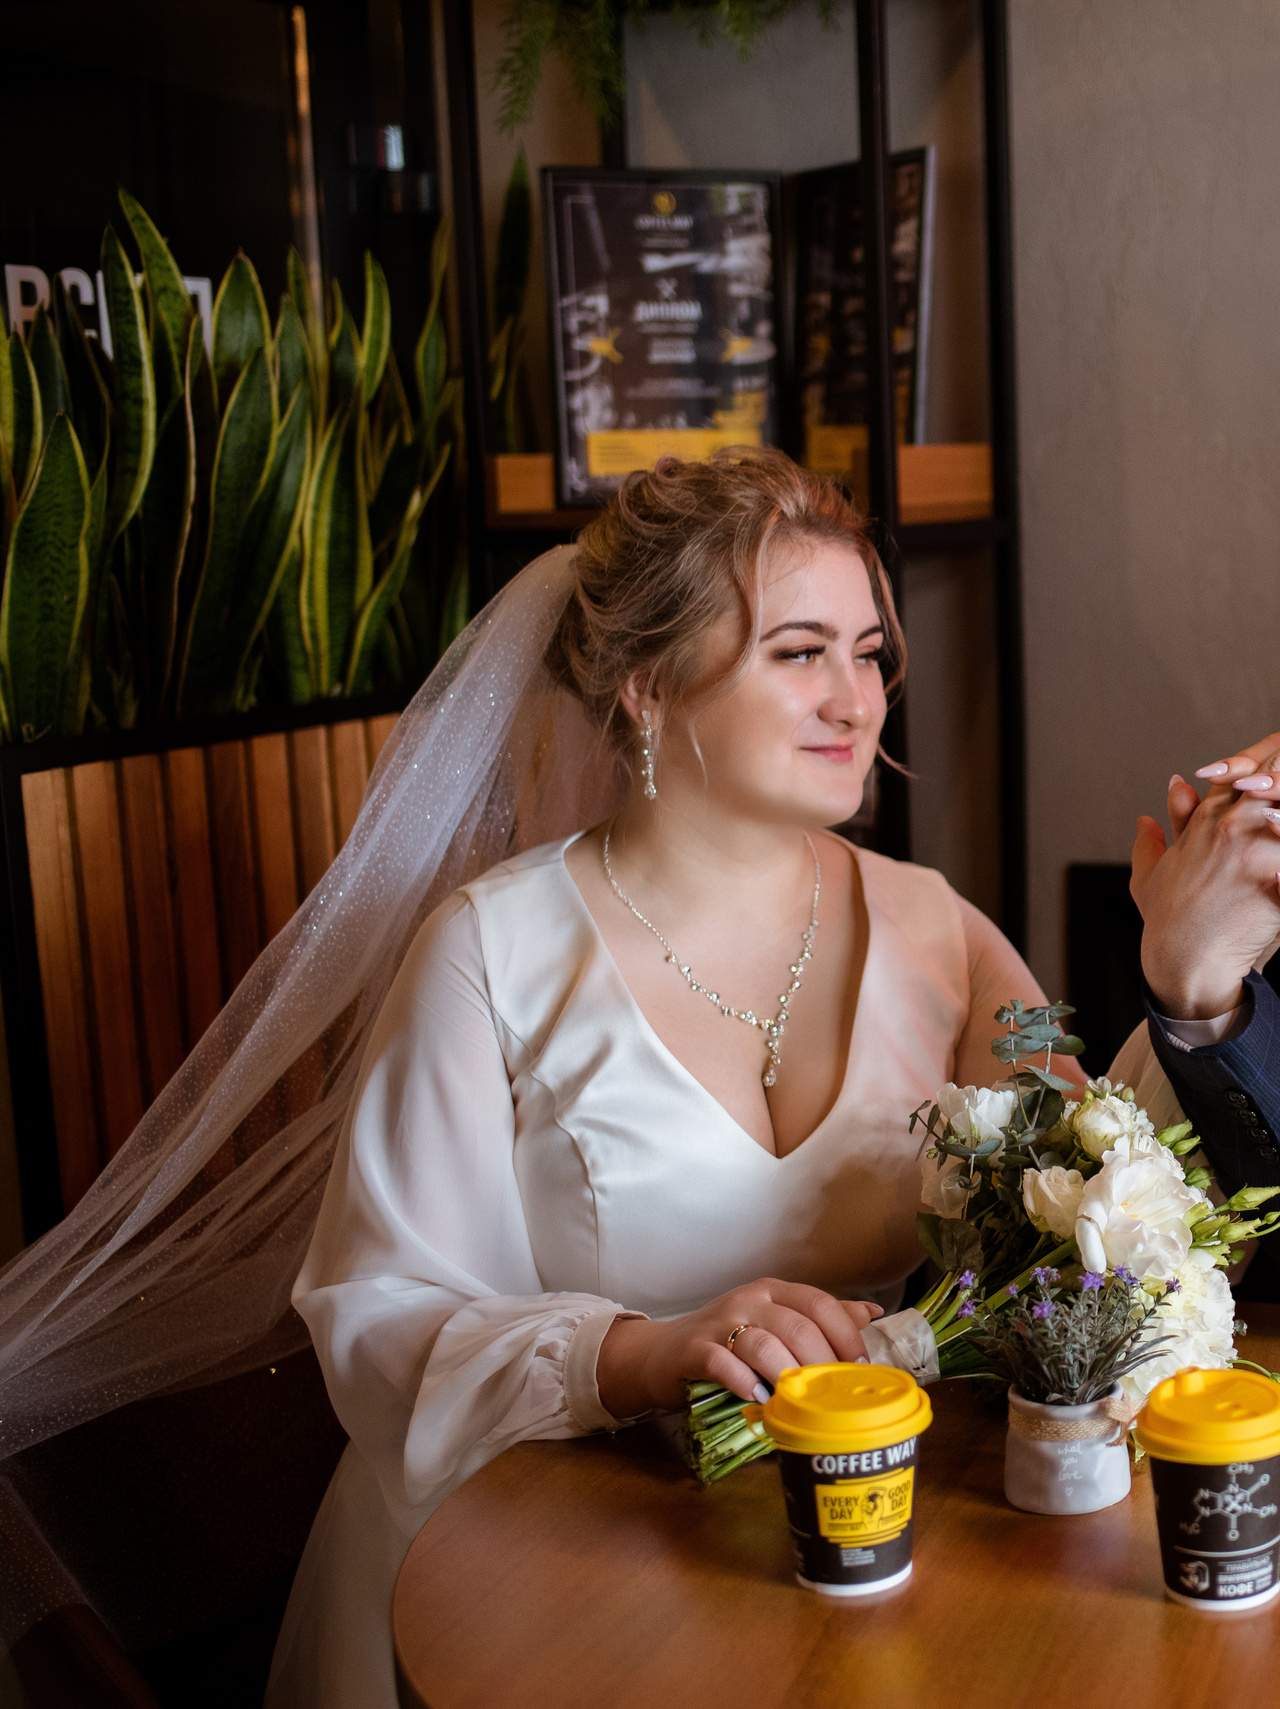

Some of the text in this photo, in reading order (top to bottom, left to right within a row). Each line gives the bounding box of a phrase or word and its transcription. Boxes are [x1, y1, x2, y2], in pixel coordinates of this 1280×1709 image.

[812, 1436, 917, 1474] COFFEE WAY
[1057, 1442, 1083, 1455] what
[1061, 1457, 1078, 1471] you
[1057, 1470, 1083, 1482] love
[888, 1480, 911, 1499] GOOD
[823, 1495, 859, 1507] EVERY
[891, 1495, 907, 1511] DAY
[830, 1508, 854, 1520] DAY
[1218, 1581, 1254, 1597] КОФЕ
